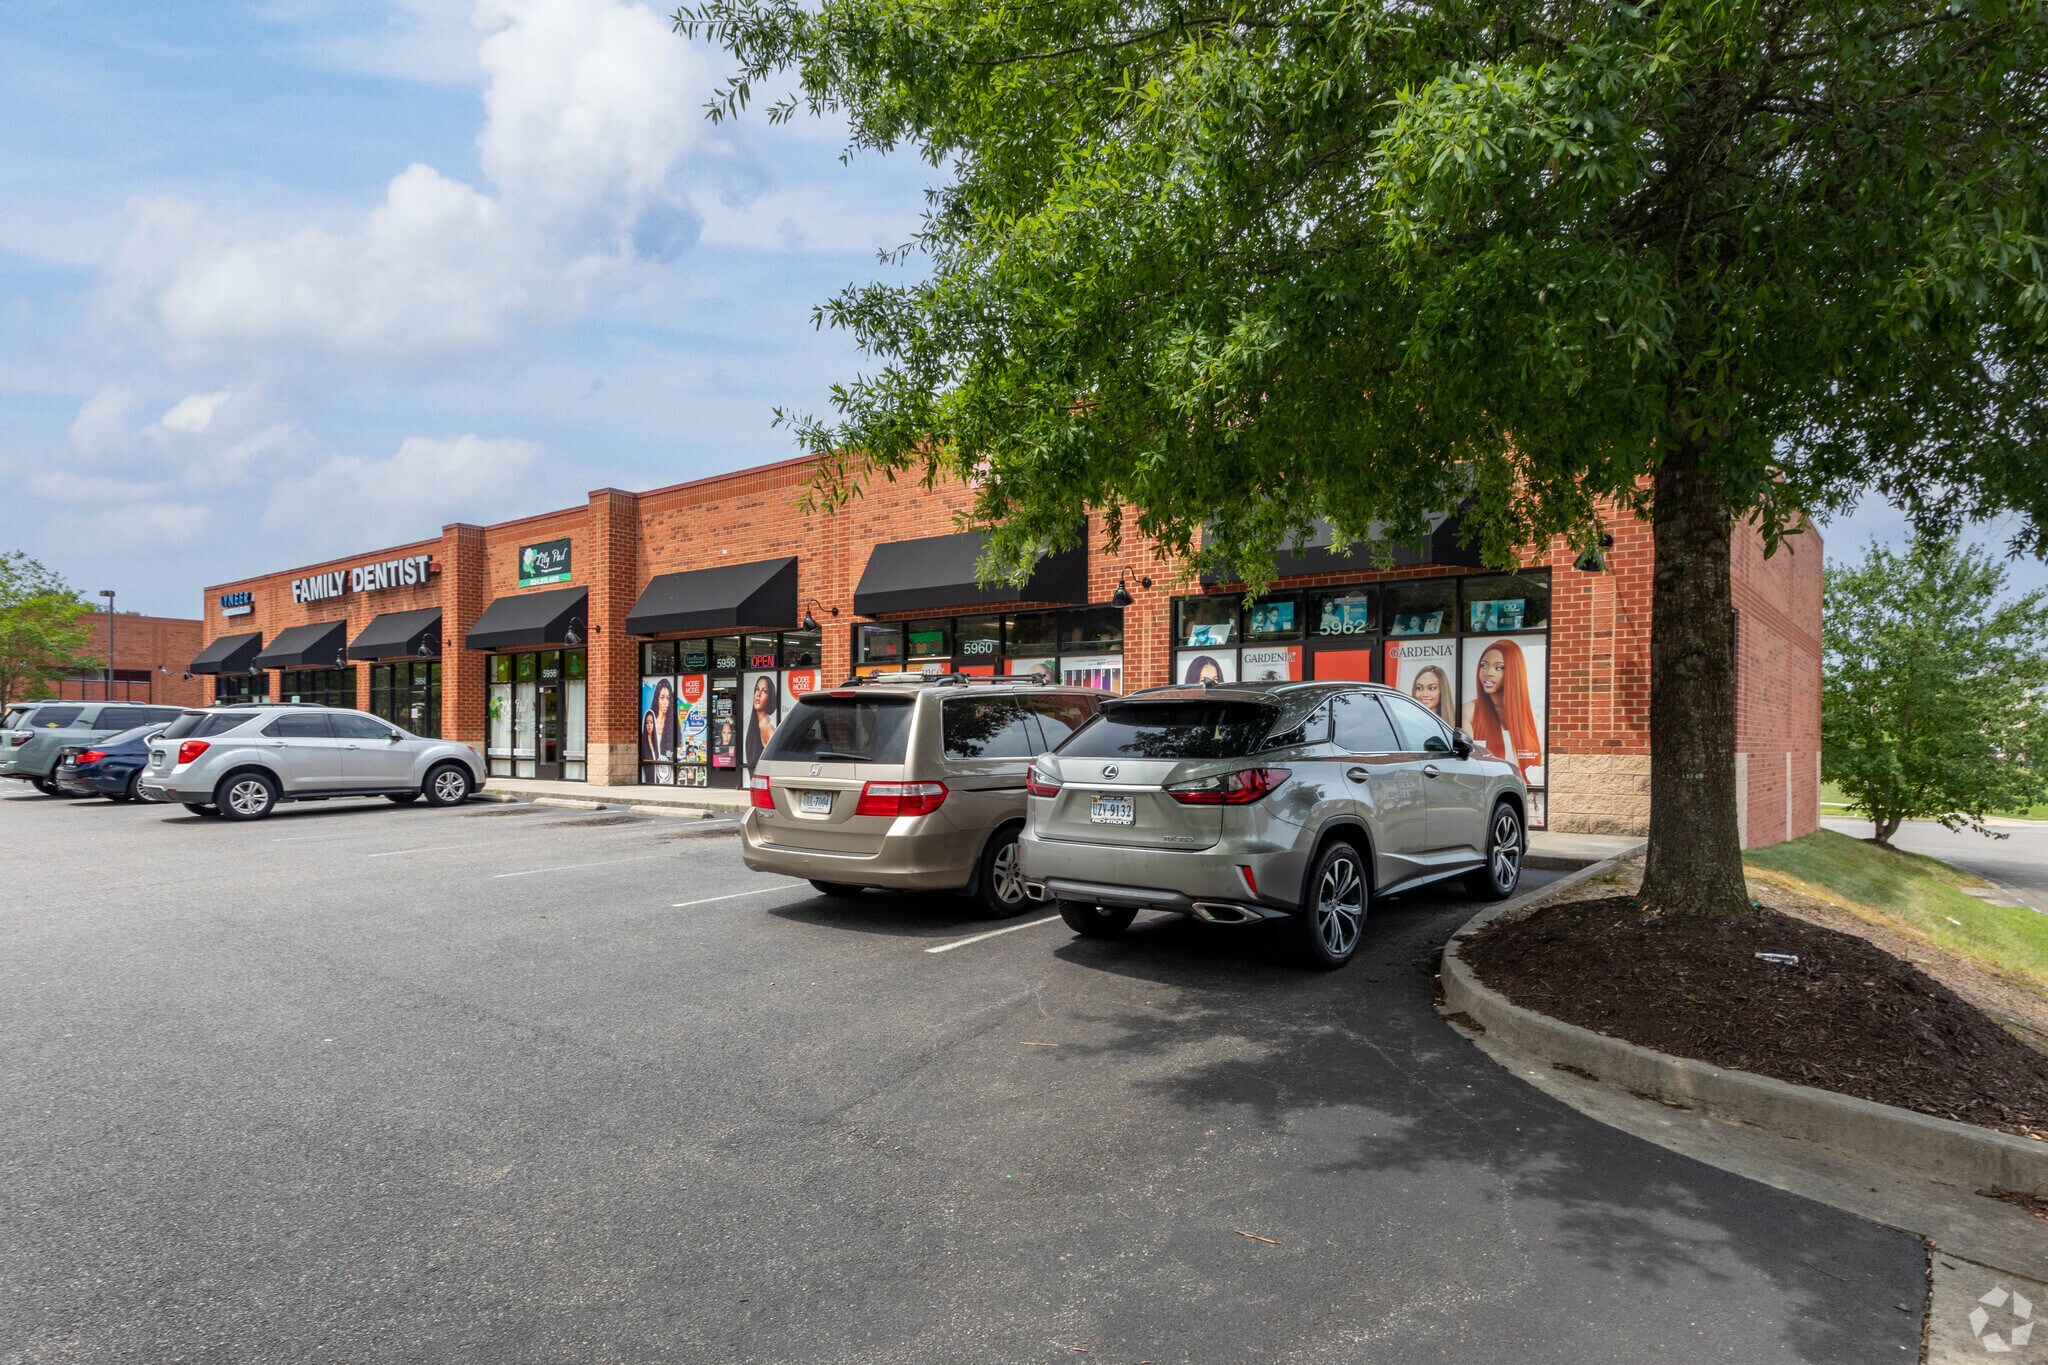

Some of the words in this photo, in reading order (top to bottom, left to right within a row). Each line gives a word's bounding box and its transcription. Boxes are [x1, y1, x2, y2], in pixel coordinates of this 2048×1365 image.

[536, 551, 551, 569] Lily
[552, 547, 568, 563] Pad
[291, 570, 347, 604] FAMILY
[352, 555, 430, 593] DENTIST
[1319, 619, 1367, 636] 5962
[963, 641, 993, 655] 5960
[1389, 645, 1452, 659] GARDENIA
[716, 657, 736, 669] 5958
[752, 655, 774, 667] OPEN
[1244, 652, 1295, 664] GARDENIA
[542, 669, 558, 678] 5956
[793, 675, 810, 683] MODEL
[793, 683, 810, 691] MODEL
